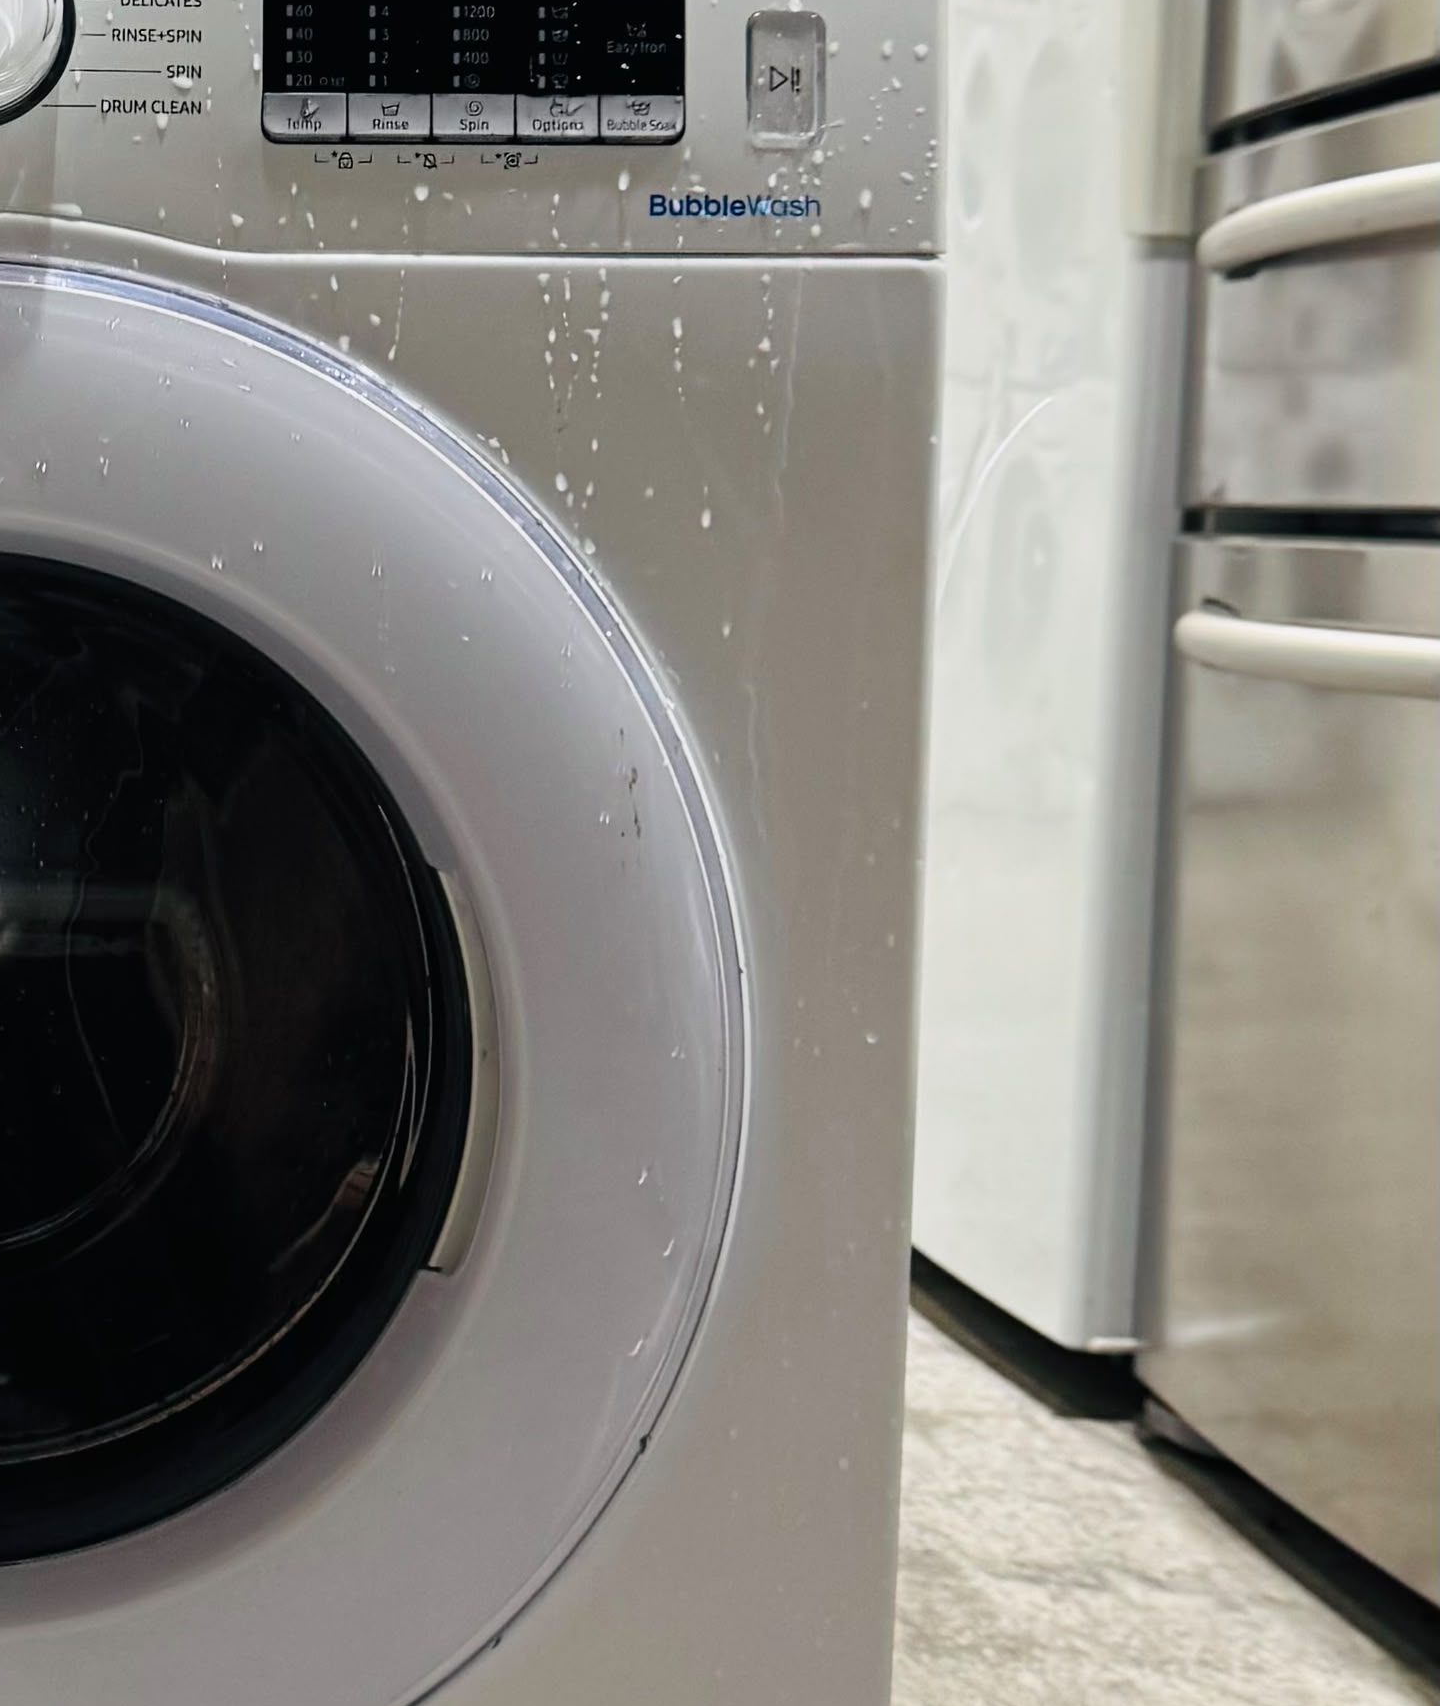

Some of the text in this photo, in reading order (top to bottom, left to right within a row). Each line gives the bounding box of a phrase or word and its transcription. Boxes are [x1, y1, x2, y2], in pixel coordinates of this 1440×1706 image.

[295, 4, 313, 17] 60
[381, 5, 390, 17] 4
[463, 5, 495, 18] 1200
[111, 28, 202, 43] RINSE+SPIN
[295, 27, 313, 40] 40
[382, 28, 390, 41] 3
[463, 28, 490, 41] 800
[606, 40, 667, 56] Easy Iron
[295, 51, 313, 63] 30
[381, 52, 389, 64] 2
[462, 52, 490, 64] 400
[166, 64, 202, 79] SPIN
[295, 74, 312, 86] 20
[100, 99, 202, 114] DRUM CLEAN
[372, 118, 409, 130] Rinse
[459, 118, 489, 132] Spin
[607, 119, 646, 131] Bubble
[649, 194, 821, 218] BubbleWash
